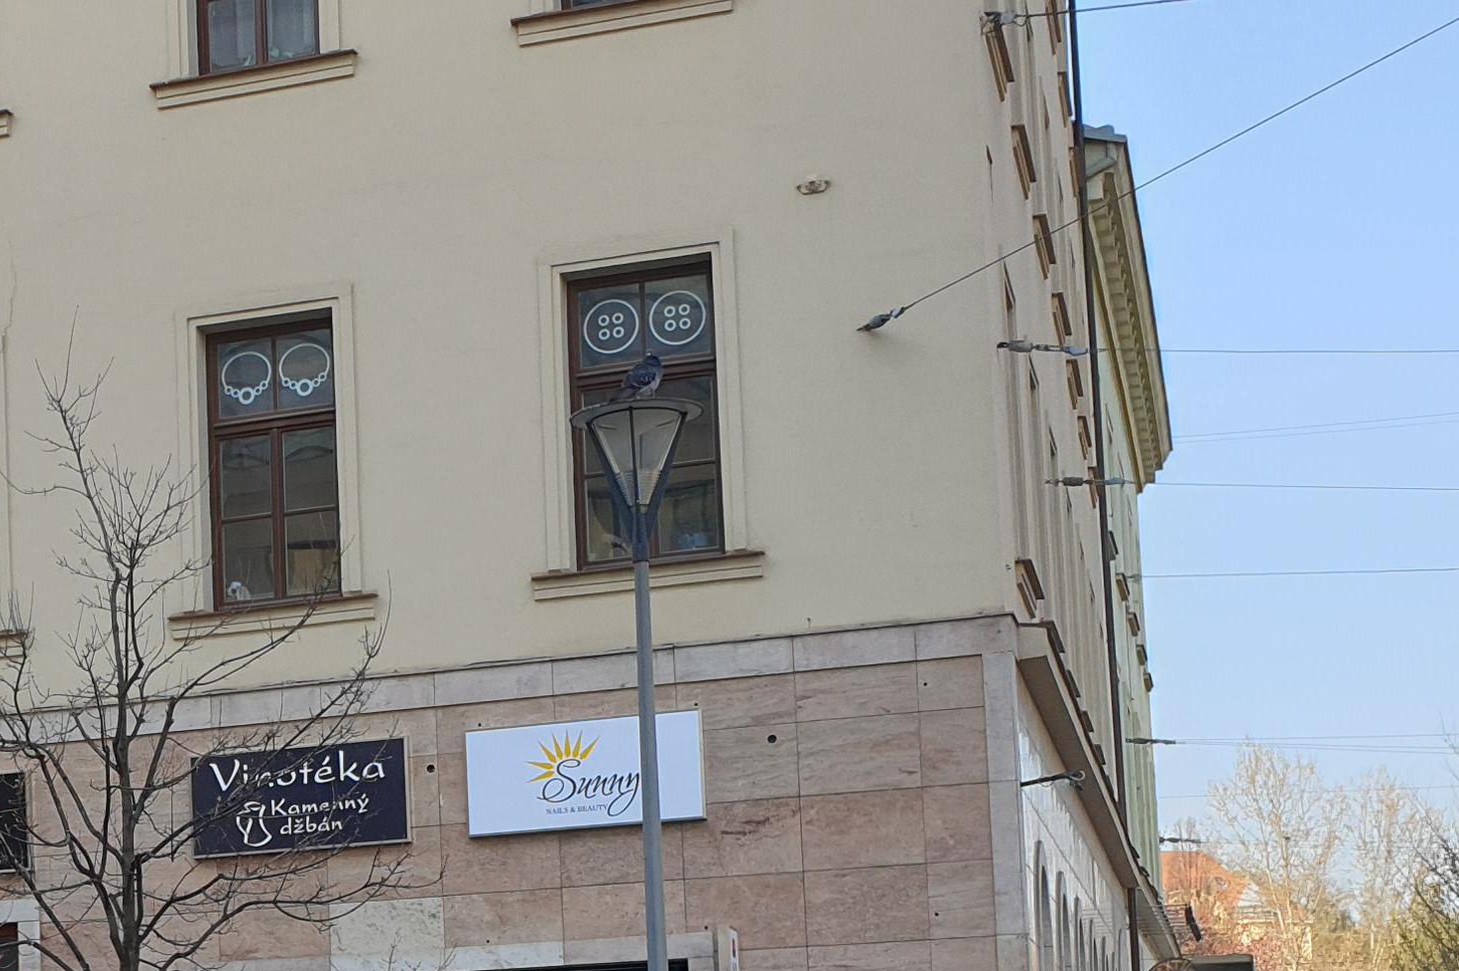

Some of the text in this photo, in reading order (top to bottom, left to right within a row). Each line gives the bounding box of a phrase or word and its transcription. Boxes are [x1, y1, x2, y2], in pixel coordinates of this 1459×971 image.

[209, 750, 386, 792] Vinotéka
[537, 758, 640, 817] Sunny
[271, 793, 370, 816] Kamenný
[578, 803, 607, 812] BEAUTY
[280, 816, 343, 835] džbán
